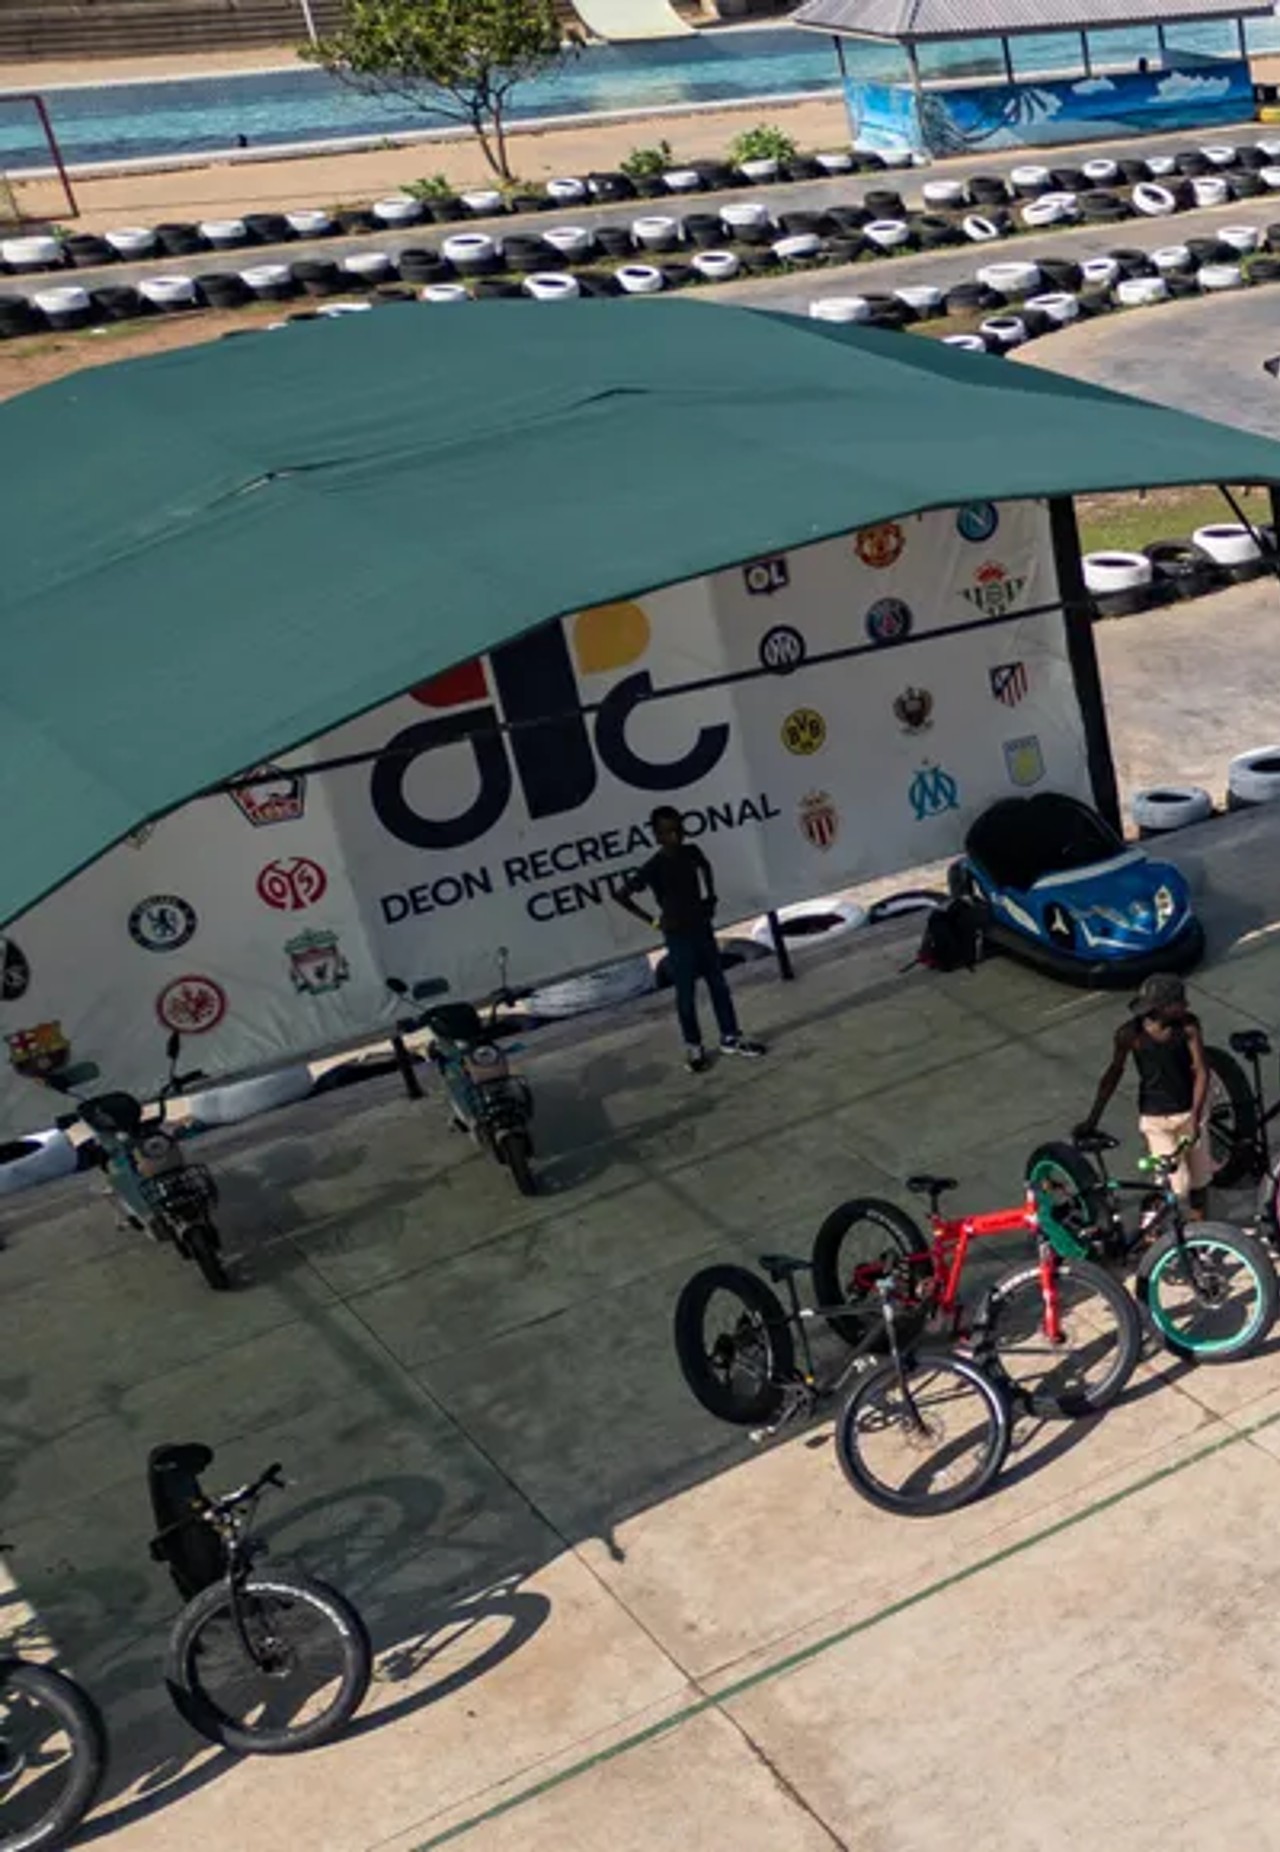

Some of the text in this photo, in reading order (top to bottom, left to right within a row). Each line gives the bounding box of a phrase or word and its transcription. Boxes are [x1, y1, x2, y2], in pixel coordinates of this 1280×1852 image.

[379, 792, 781, 924] DEON RECREAONAL
[526, 865, 647, 921] CENTR
